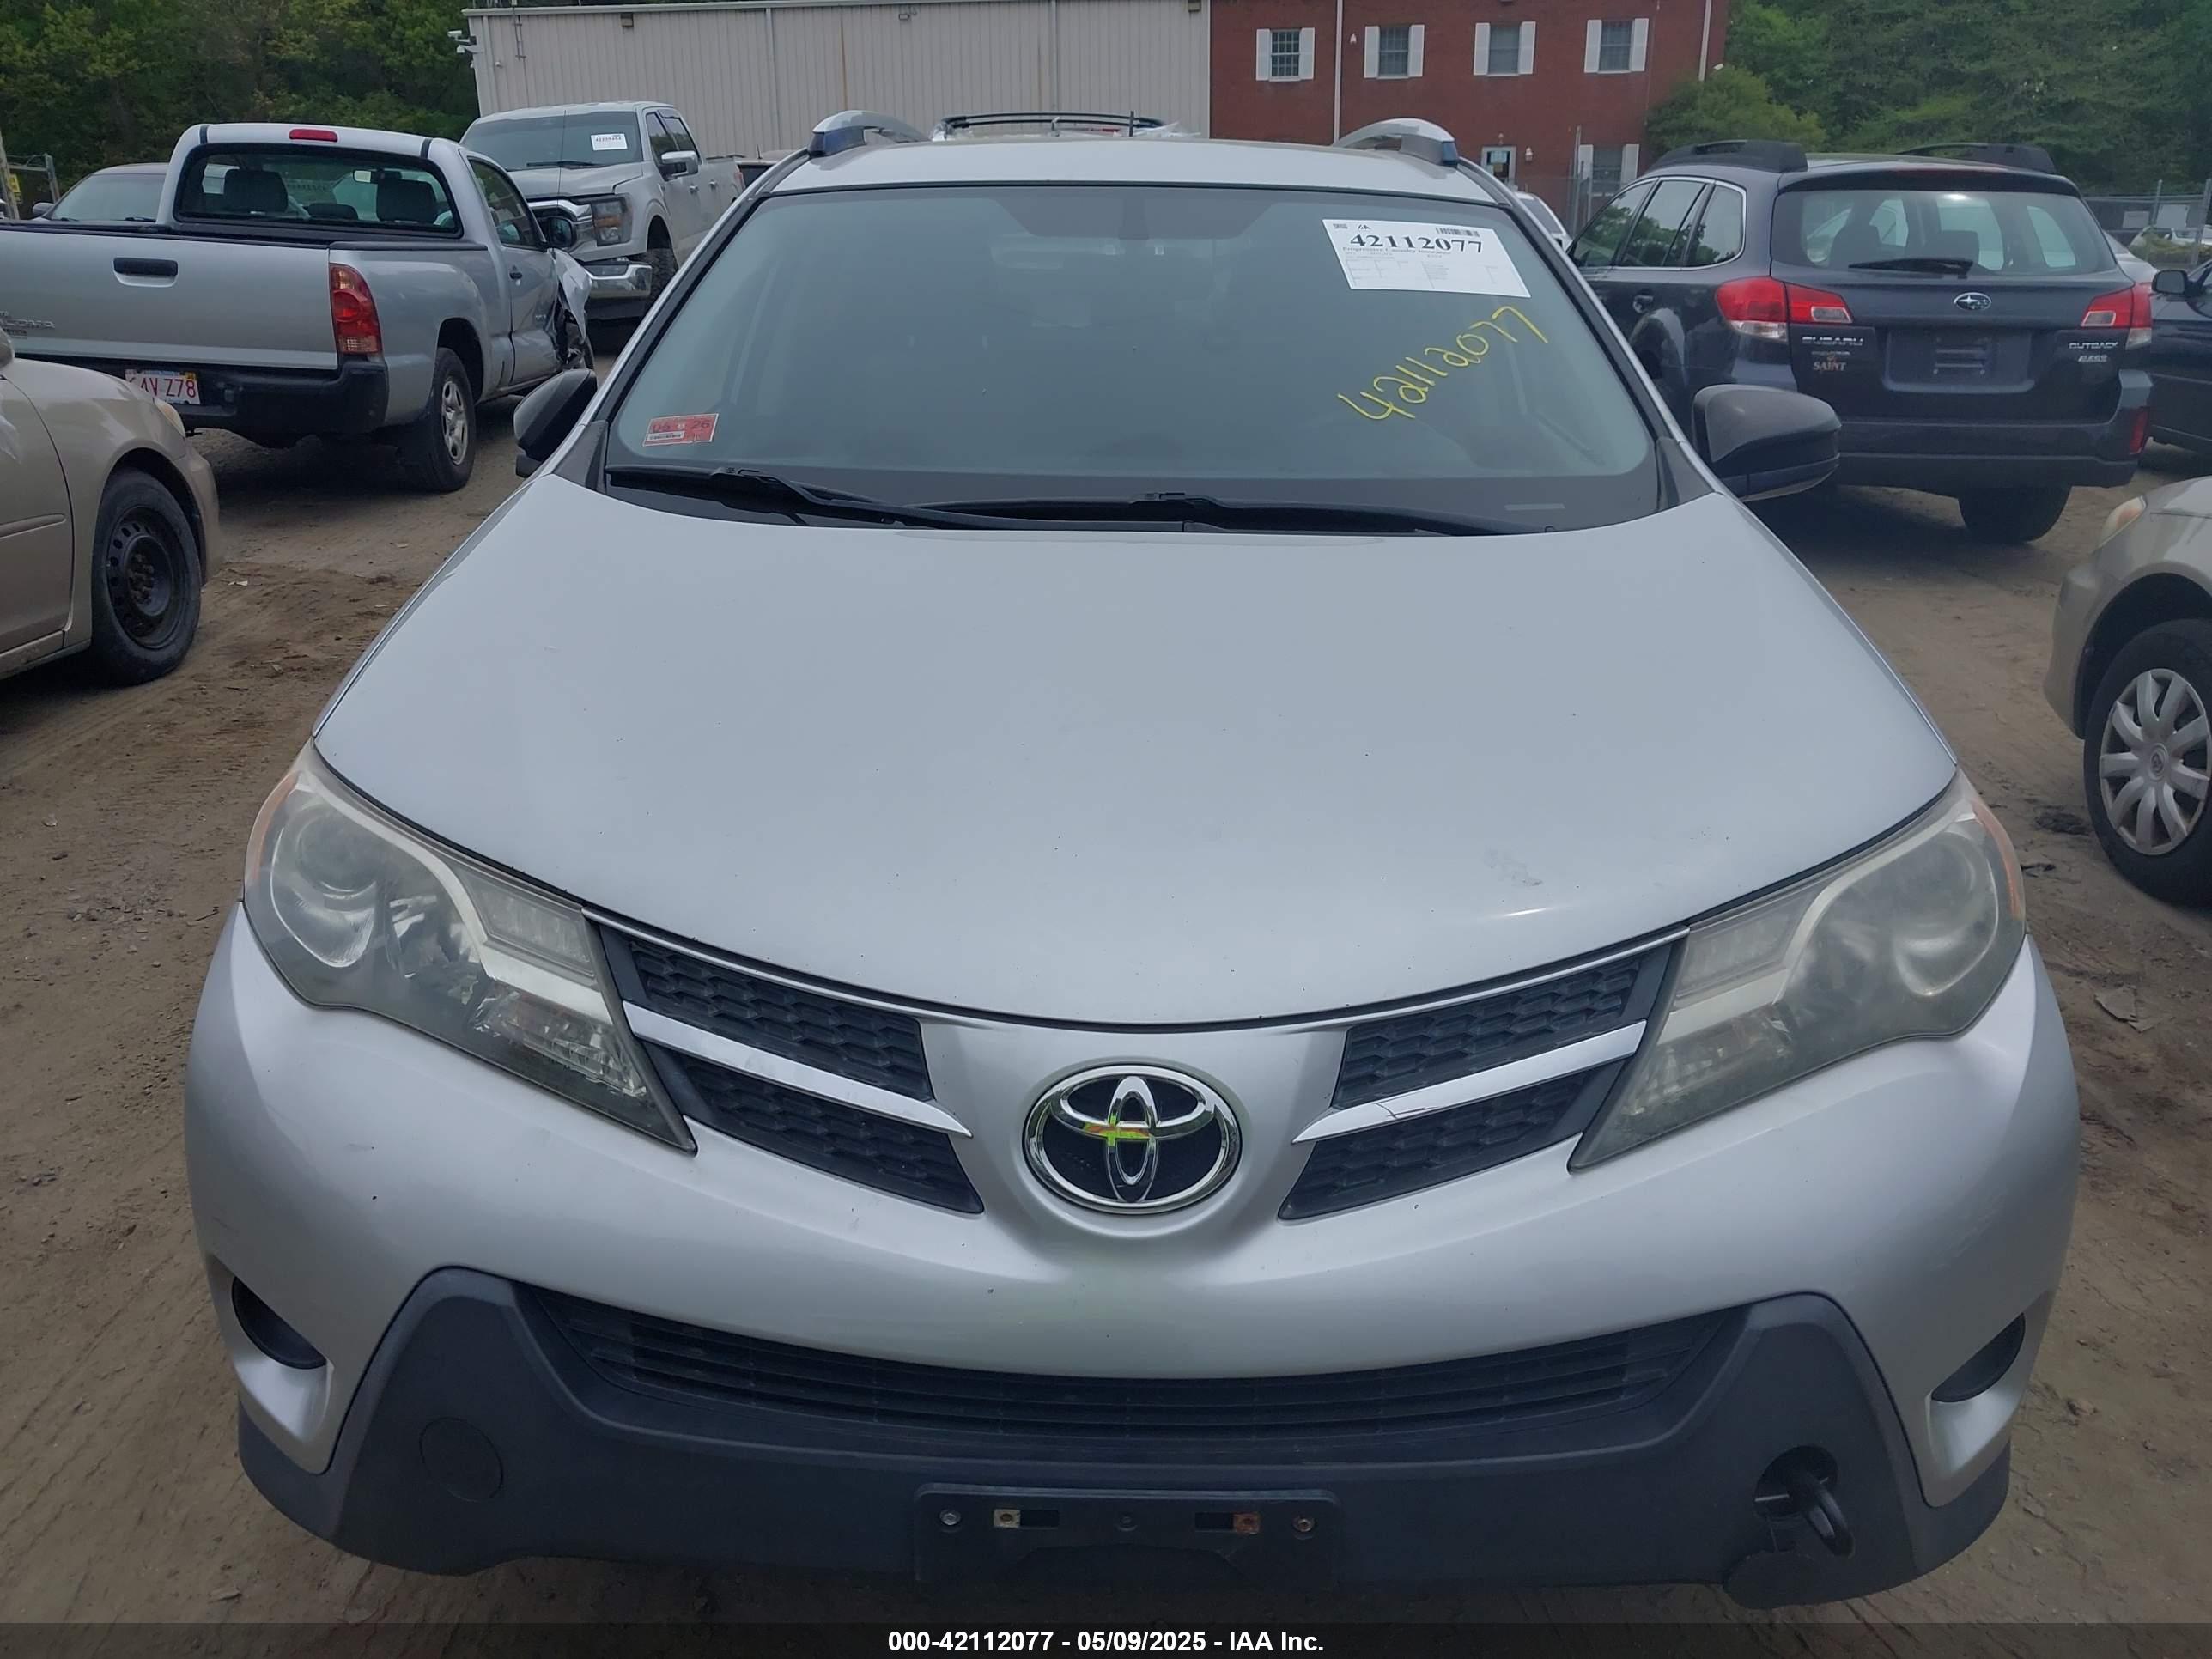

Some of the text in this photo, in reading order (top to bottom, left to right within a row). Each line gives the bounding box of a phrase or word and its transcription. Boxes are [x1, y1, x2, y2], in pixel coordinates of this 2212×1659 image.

[1350, 234, 1482, 253] 42112077
[1802, 336, 1864, 346] SUBARU
[2069, 341, 2119, 349] OUTBACK
[1337, 306, 1548, 420] 42112077
